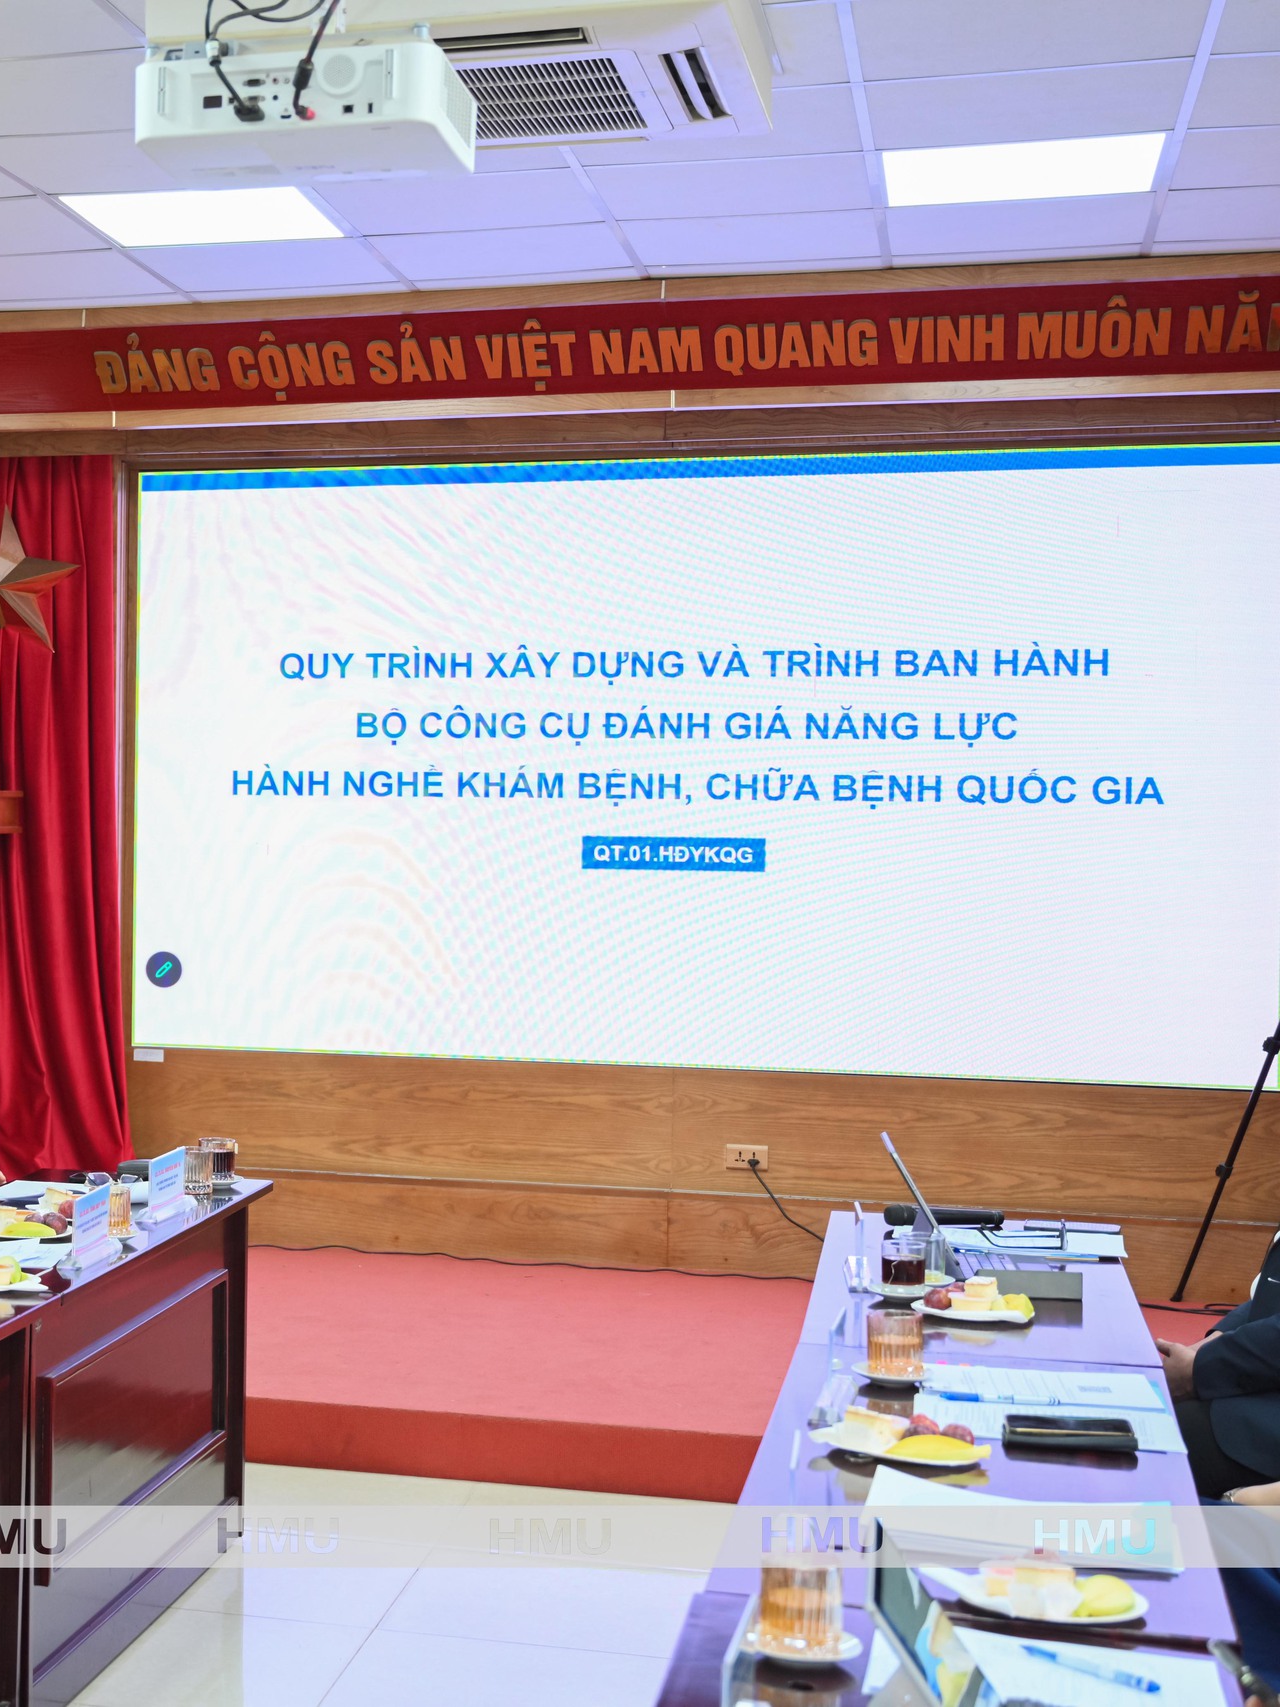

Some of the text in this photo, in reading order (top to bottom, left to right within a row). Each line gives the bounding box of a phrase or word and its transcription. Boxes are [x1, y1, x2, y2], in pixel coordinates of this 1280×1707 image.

[94, 289, 1280, 401] ĐẢNG CỘNG SẢN VIỆT NAM QUANG VINH MUÔN NĂ
[280, 641, 1110, 687] QUY TRÌNH XÂY DỰNG VÀ TRÌNH BAN HÀNH
[356, 704, 1018, 749] BỘ CÔNG CỤ ĐÁNH GIÁ NĂNG LỰC
[232, 763, 1166, 810] HÀNH NGHỀ KHÁM BỆNH, CHỮA BỆNH QUỐC GIA
[593, 844, 754, 865] QT.01.HĐYKQG
